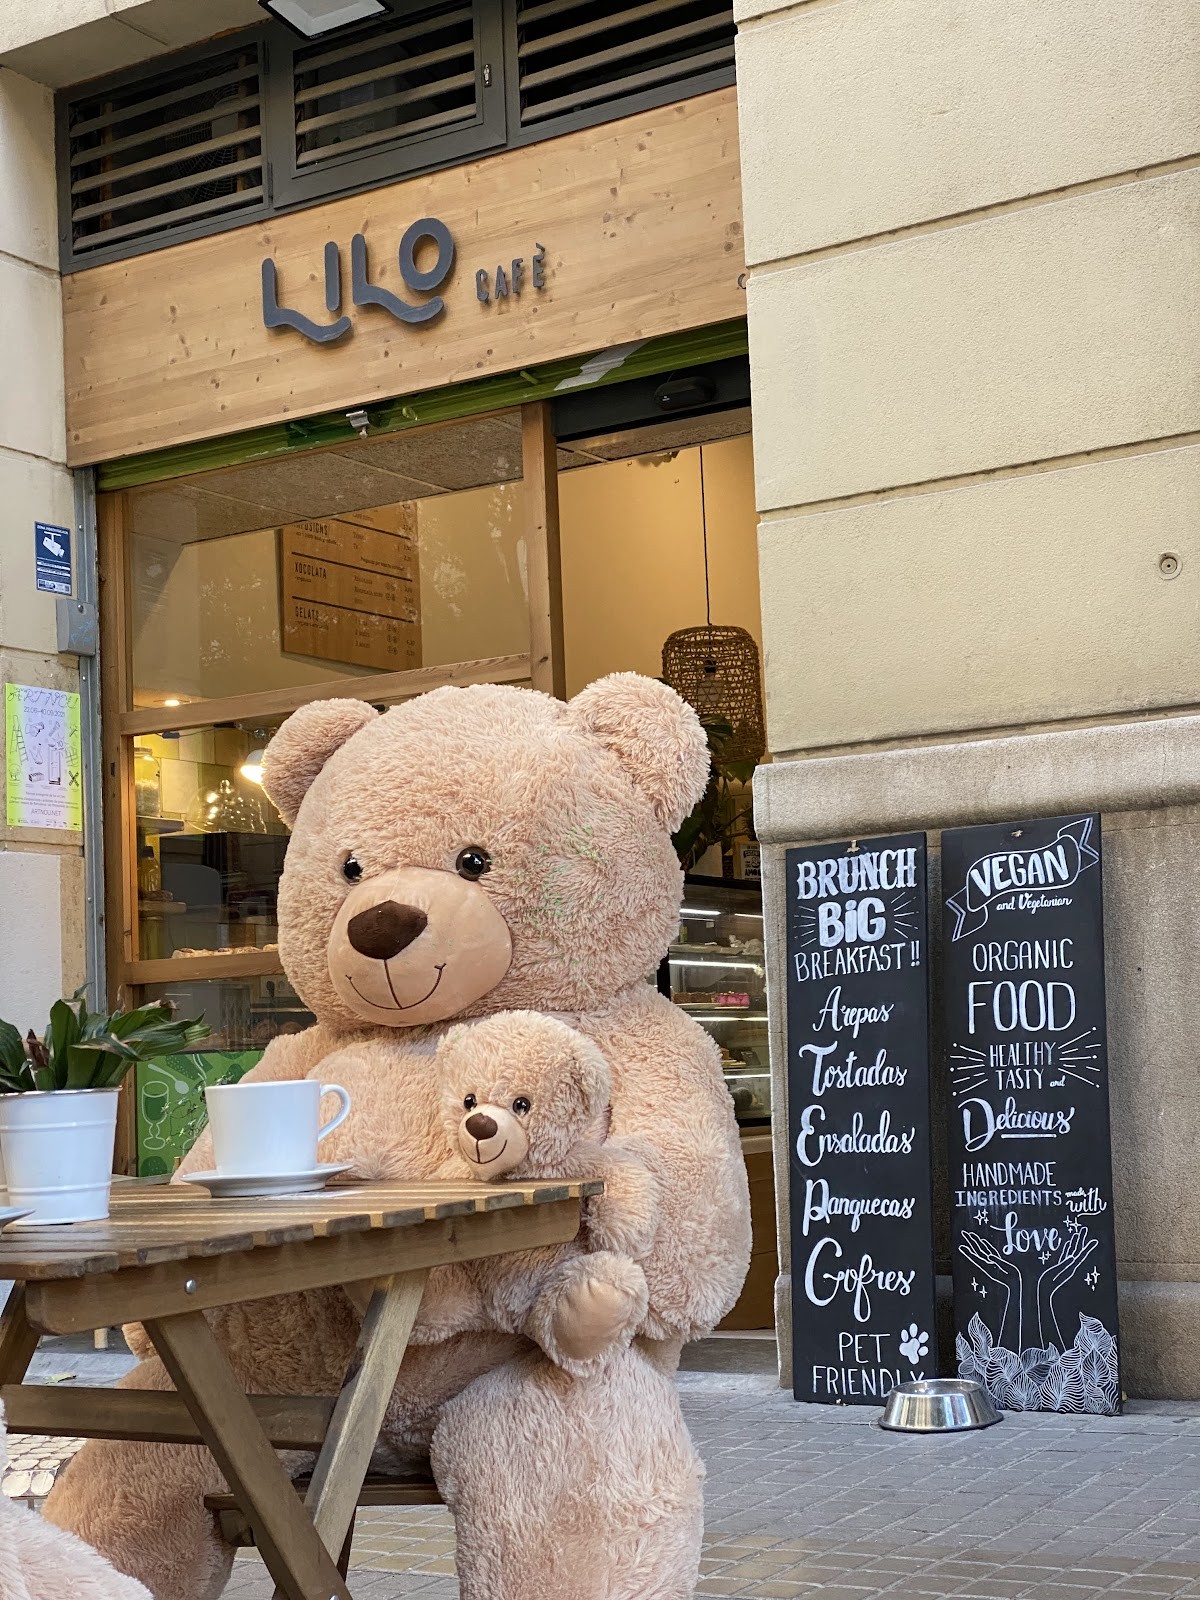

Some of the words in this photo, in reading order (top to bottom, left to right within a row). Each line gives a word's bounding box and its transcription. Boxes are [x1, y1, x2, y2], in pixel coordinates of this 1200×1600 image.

[261, 217, 454, 342] LILO
[294, 561, 328, 579] XOCOLATA
[796, 847, 918, 900] BRUNCH
[970, 844, 1069, 898] VEGAN
[996, 896, 1016, 911] and
[1018, 892, 1073, 915] Vegetarian
[972, 938, 1074, 972] ORGANIC
[812, 985, 895, 1039] Arepas
[968, 979, 1076, 1035] FOOD
[798, 1040, 908, 1096] Tostadas
[989, 1041, 1057, 1067] HEALTHY
[995, 1067, 1044, 1091] TASTY
[1049, 1074, 1066, 1088] and
[796, 1104, 916, 1167] Ensaladas
[957, 1096, 1076, 1152] Delicious
[954, 1189, 1063, 1208] INGREDIENTS
[962, 1161, 1057, 1188] HANDMADE
[802, 1178, 916, 1237] Panquecas
[1065, 1187, 1108, 1213] with
[989, 1211, 1063, 1256] Love
[804, 1237, 916, 1323] Gofres
[838, 1331, 891, 1364] PET
